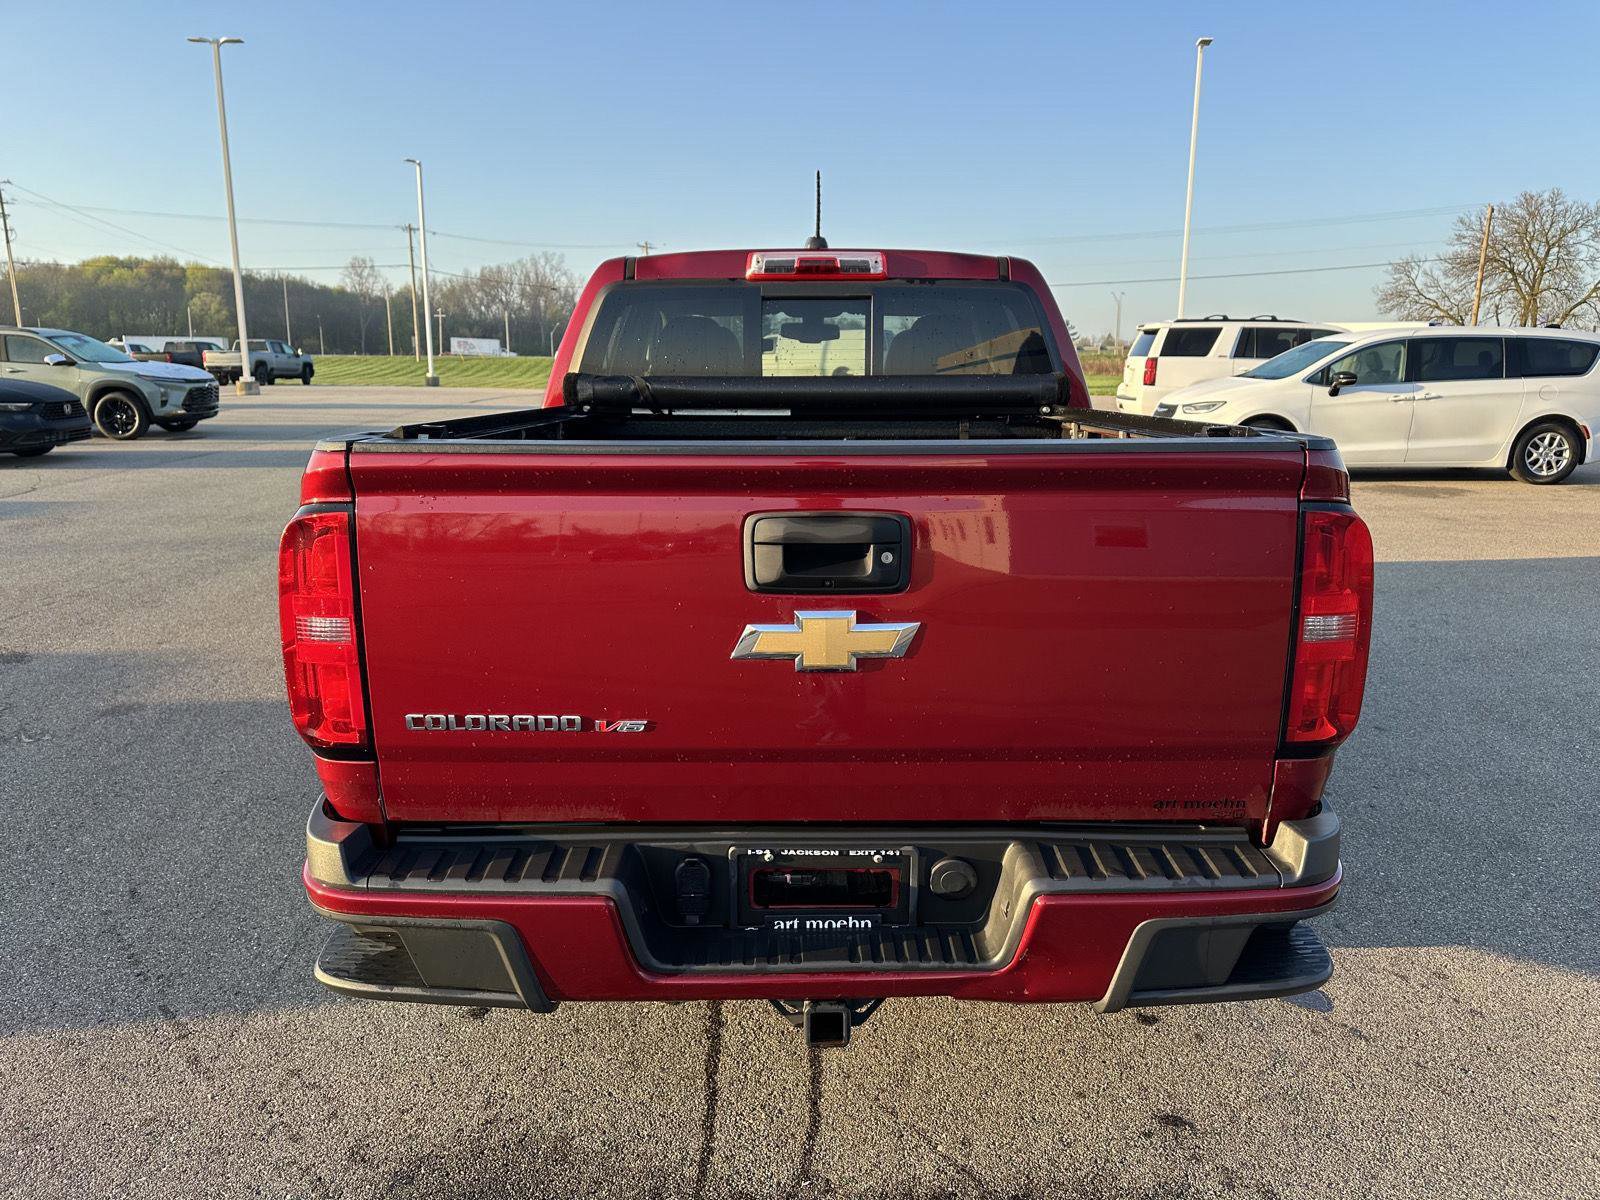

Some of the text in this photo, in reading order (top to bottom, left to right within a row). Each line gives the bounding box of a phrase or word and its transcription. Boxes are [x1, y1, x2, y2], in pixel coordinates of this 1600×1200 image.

[405, 713, 648, 732] COLORADO V6
[774, 916, 872, 930] art moehn
